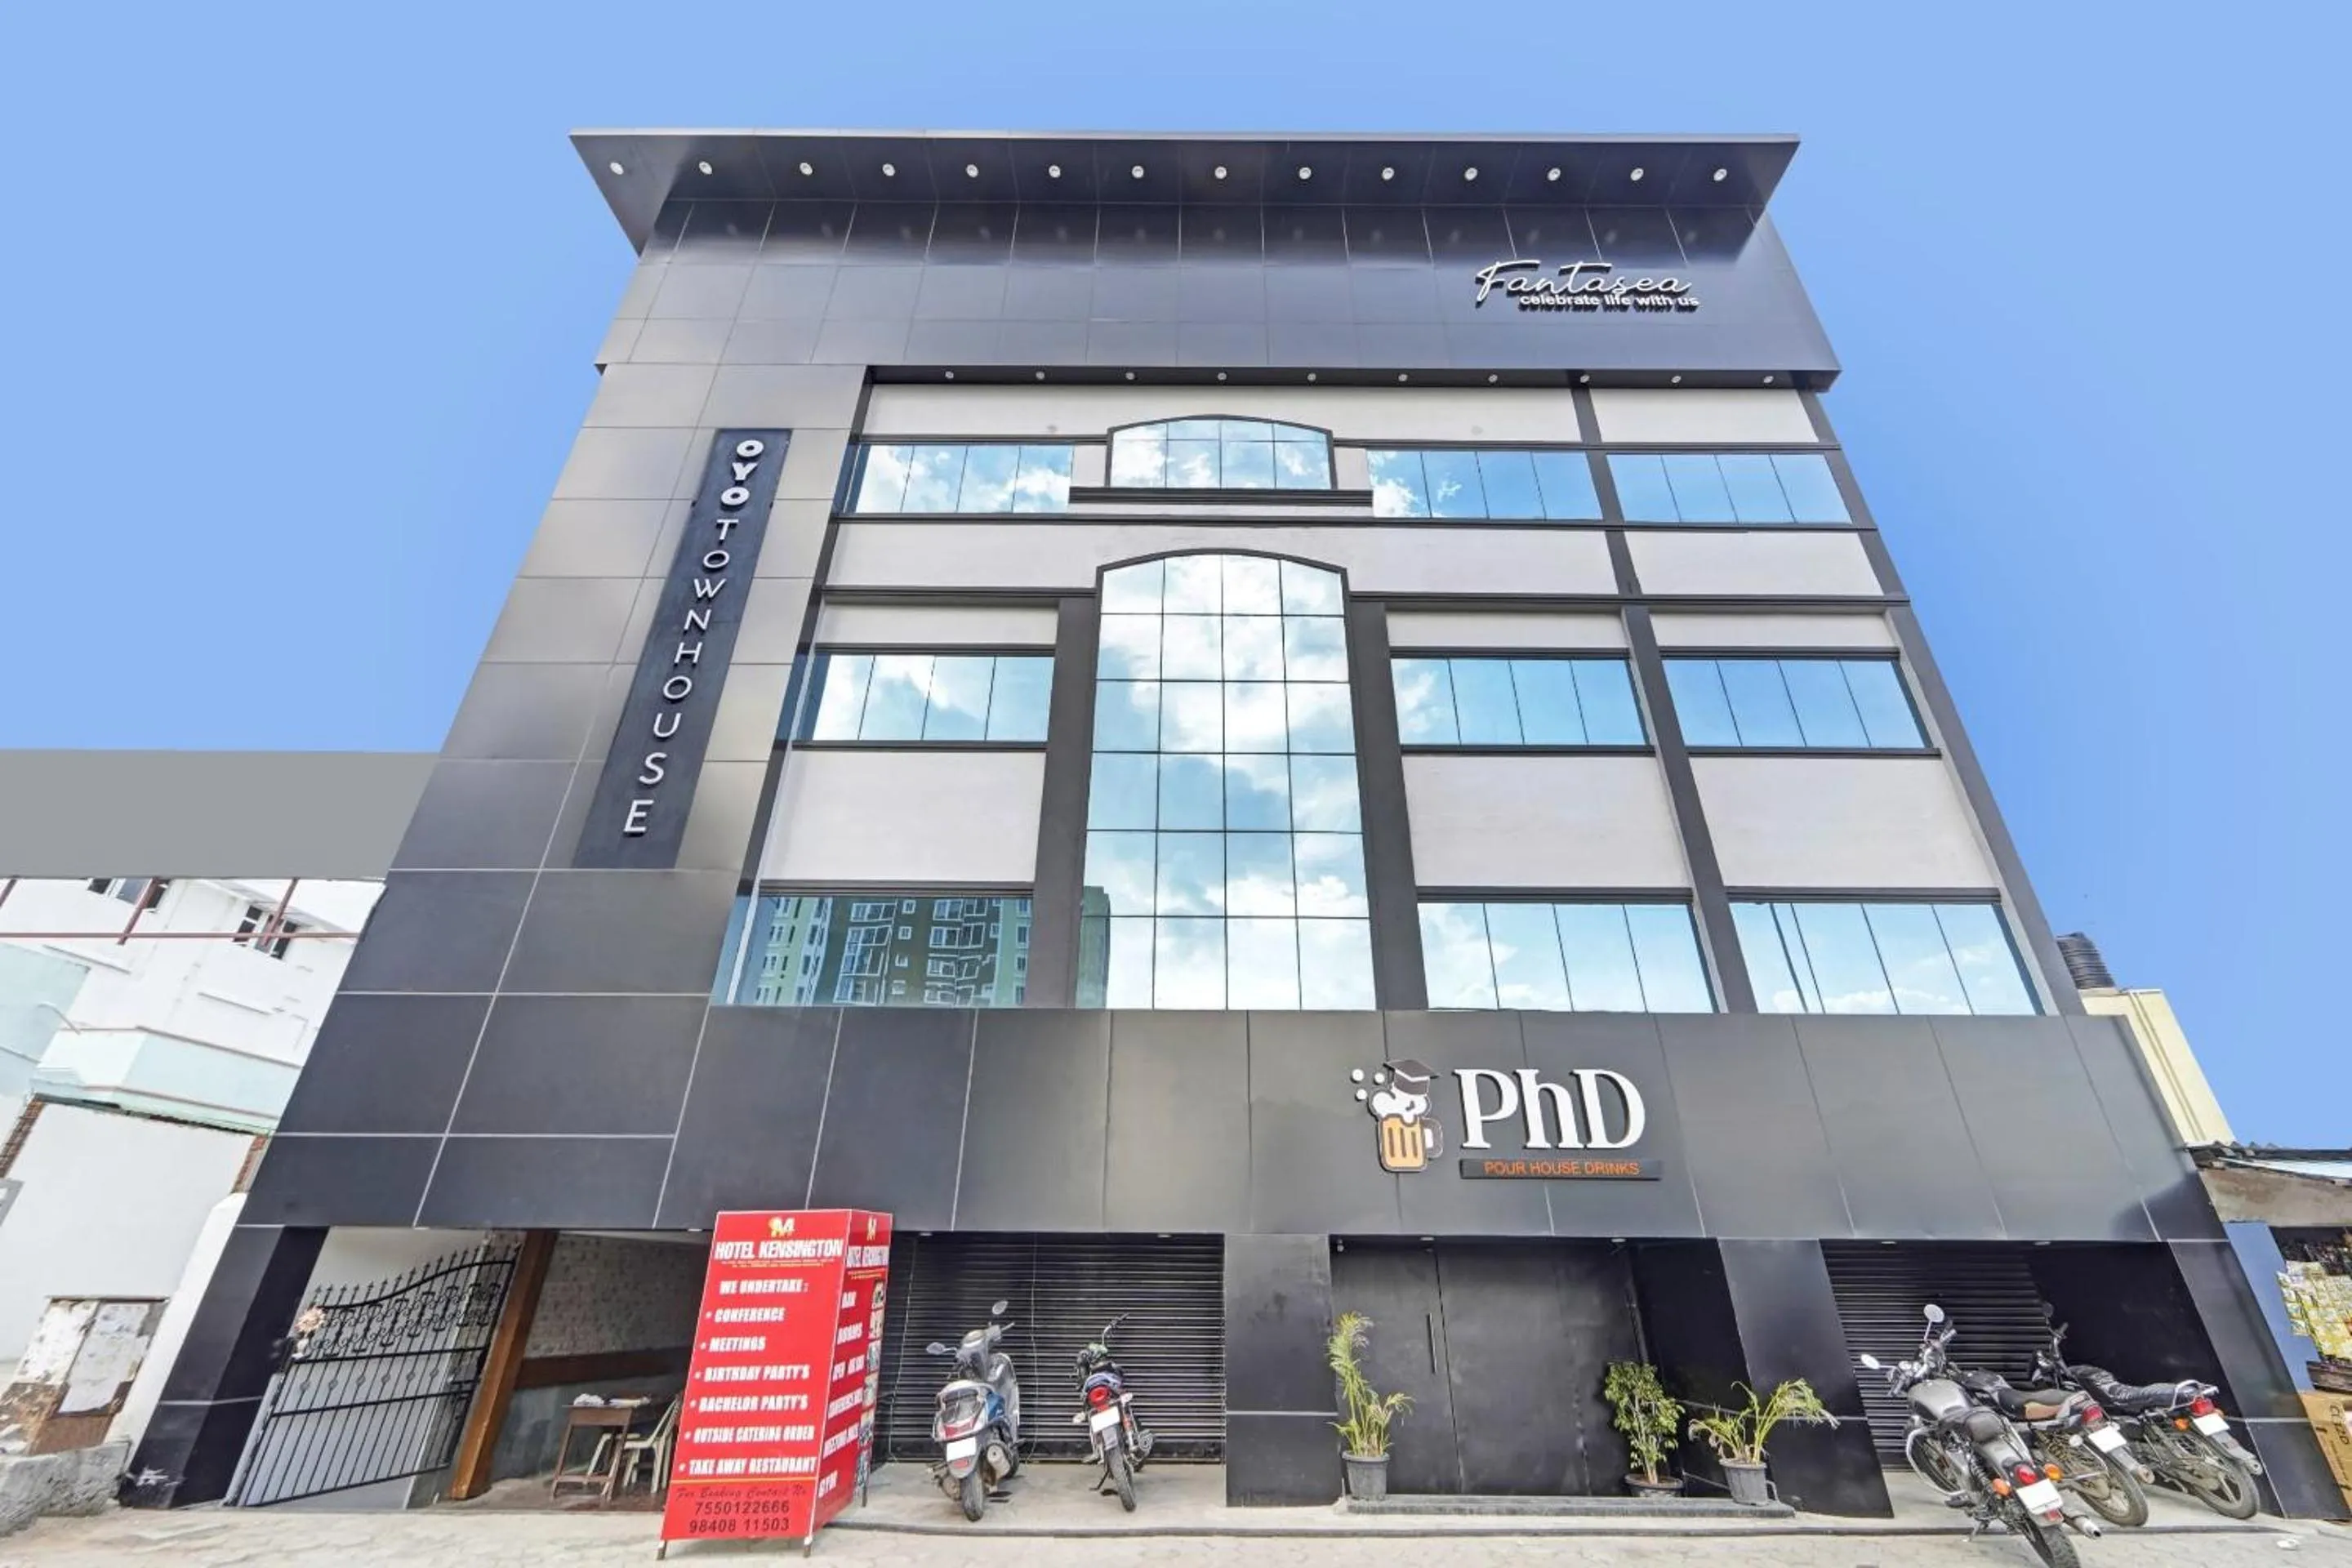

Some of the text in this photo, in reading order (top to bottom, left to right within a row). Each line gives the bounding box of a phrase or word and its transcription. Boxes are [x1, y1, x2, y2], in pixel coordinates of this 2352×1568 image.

[1520, 294, 1699, 307] celebrate life with us
[623, 439, 764, 834] OYO TOWNHOUSE
[1454, 1068, 1646, 1149] PhD
[1484, 1162, 1639, 1176] POUR HOUSE DRINKS
[715, 1241, 755, 1260] HOTEL
[758, 1238, 844, 1259] KENSINGTON
[719, 1280, 738, 1294] WE
[714, 1307, 786, 1323] CONFERENCE
[709, 1336, 766, 1352] MEETINGS
[704, 1364, 810, 1382] BIRTHDAY PARTY'S
[698, 1396, 759, 1412] BACHELOR
[760, 1394, 808, 1411] PARTY'S
[693, 1427, 734, 1444] OUTSIDE
[736, 1426, 782, 1442] CATERING
[783, 1425, 815, 1441] ORDER
[688, 1456, 817, 1476] TAKE AWAY RESTAURANT
[695, 1500, 790, 1516] 7550122666
[689, 1517, 790, 1534] 98408 11503
